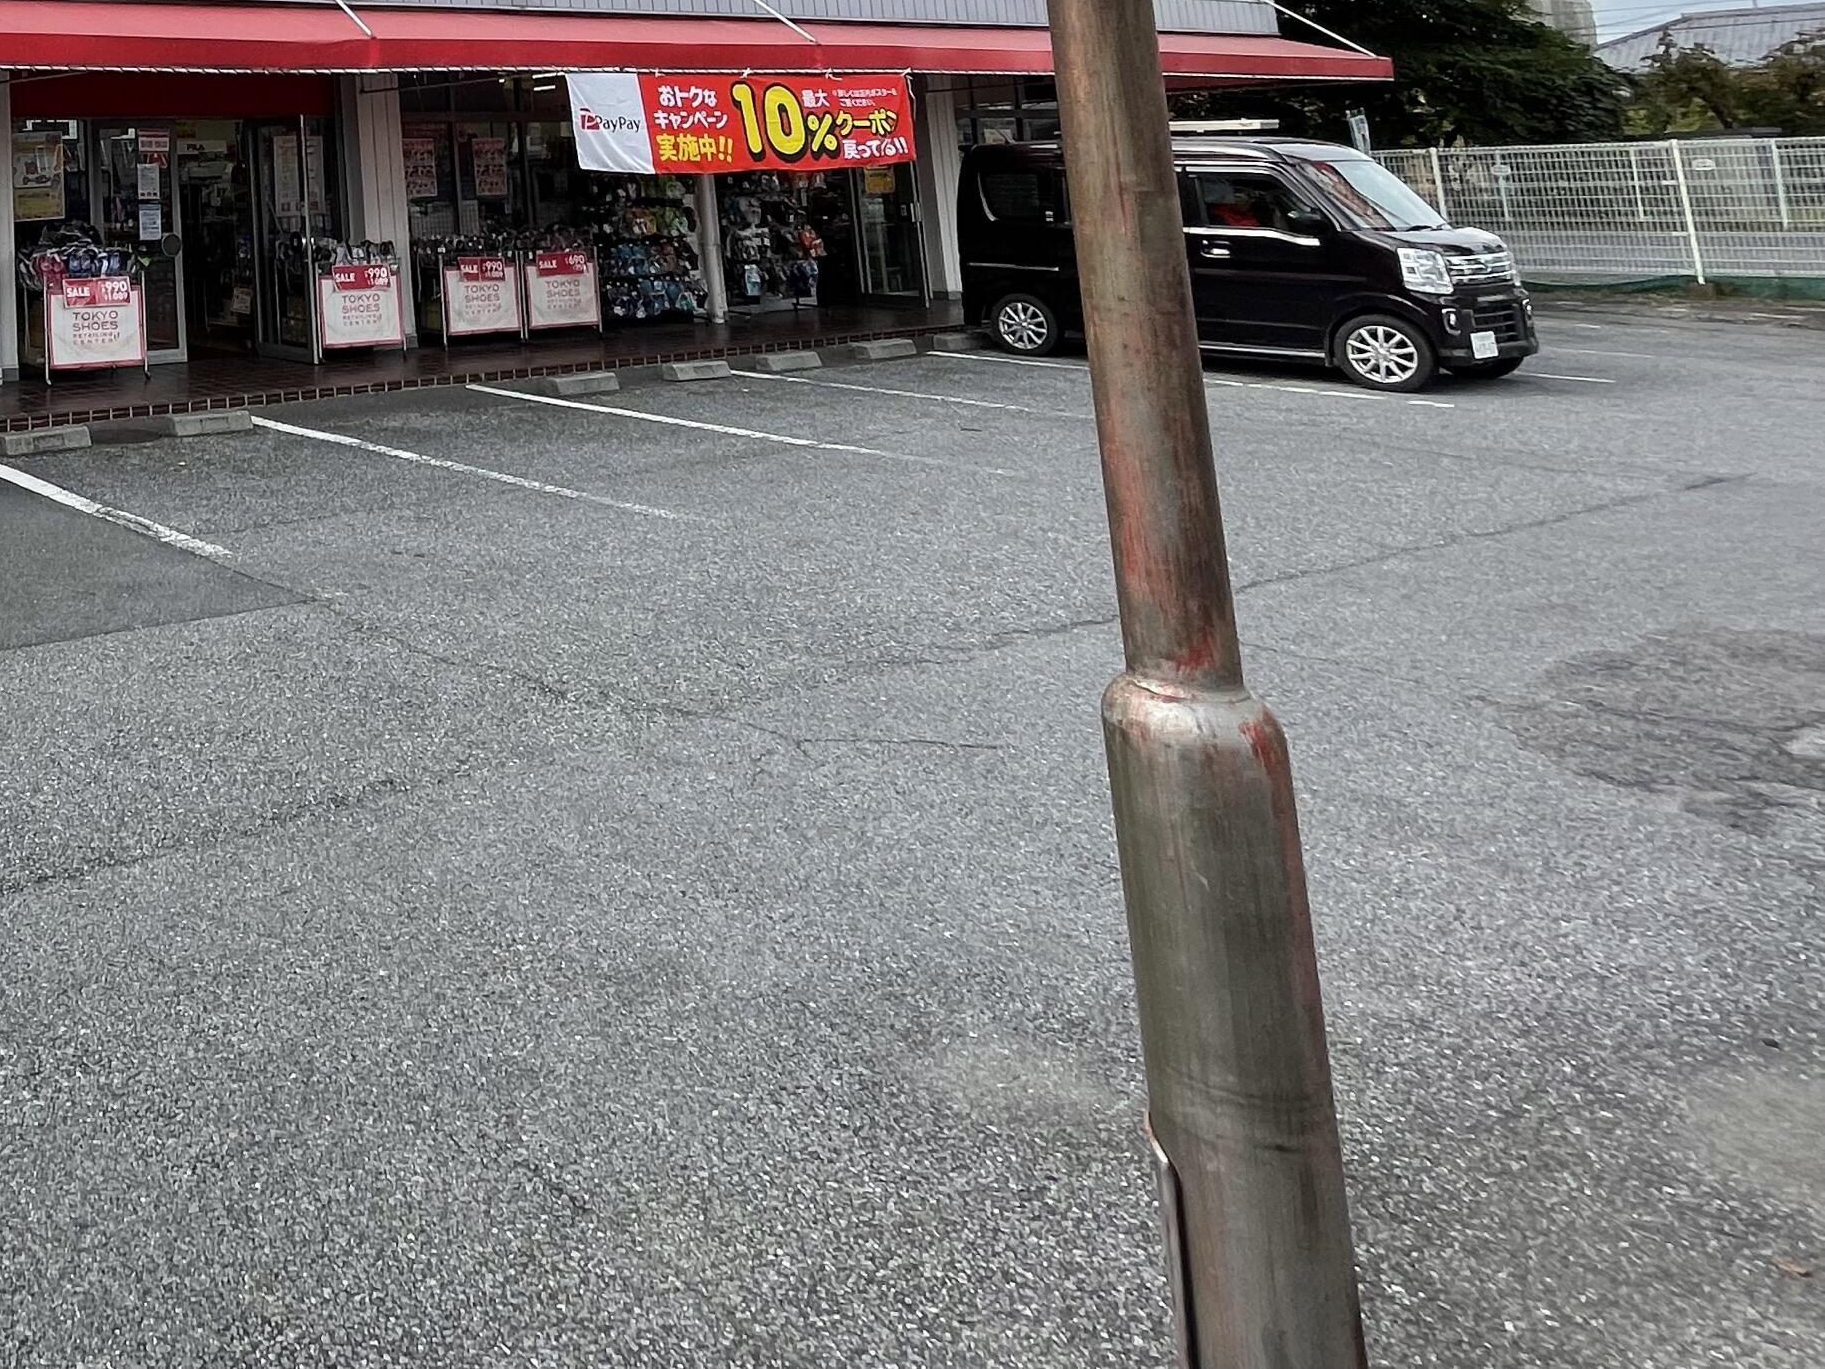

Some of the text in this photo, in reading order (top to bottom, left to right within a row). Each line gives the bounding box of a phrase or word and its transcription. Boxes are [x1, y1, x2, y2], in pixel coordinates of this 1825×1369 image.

[657, 85, 718, 108] おトクな
[801, 89, 831, 108] 最大
[597, 115, 642, 133] PayPay
[654, 109, 728, 129] キャンペーン
[460, 264, 479, 274] SALE
[539, 260, 557, 269] SALE
[335, 273, 356, 283] SALE
[66, 287, 90, 297] SALE
[464, 284, 500, 294] TOKYO
[546, 288, 580, 298] SHOES
[342, 293, 380, 304] TOKYO
[464, 294, 500, 303] SHOES
[342, 303, 380, 314] SHOES
[73, 310, 119, 321] TOKYO
[73, 321, 119, 332] SHOES
